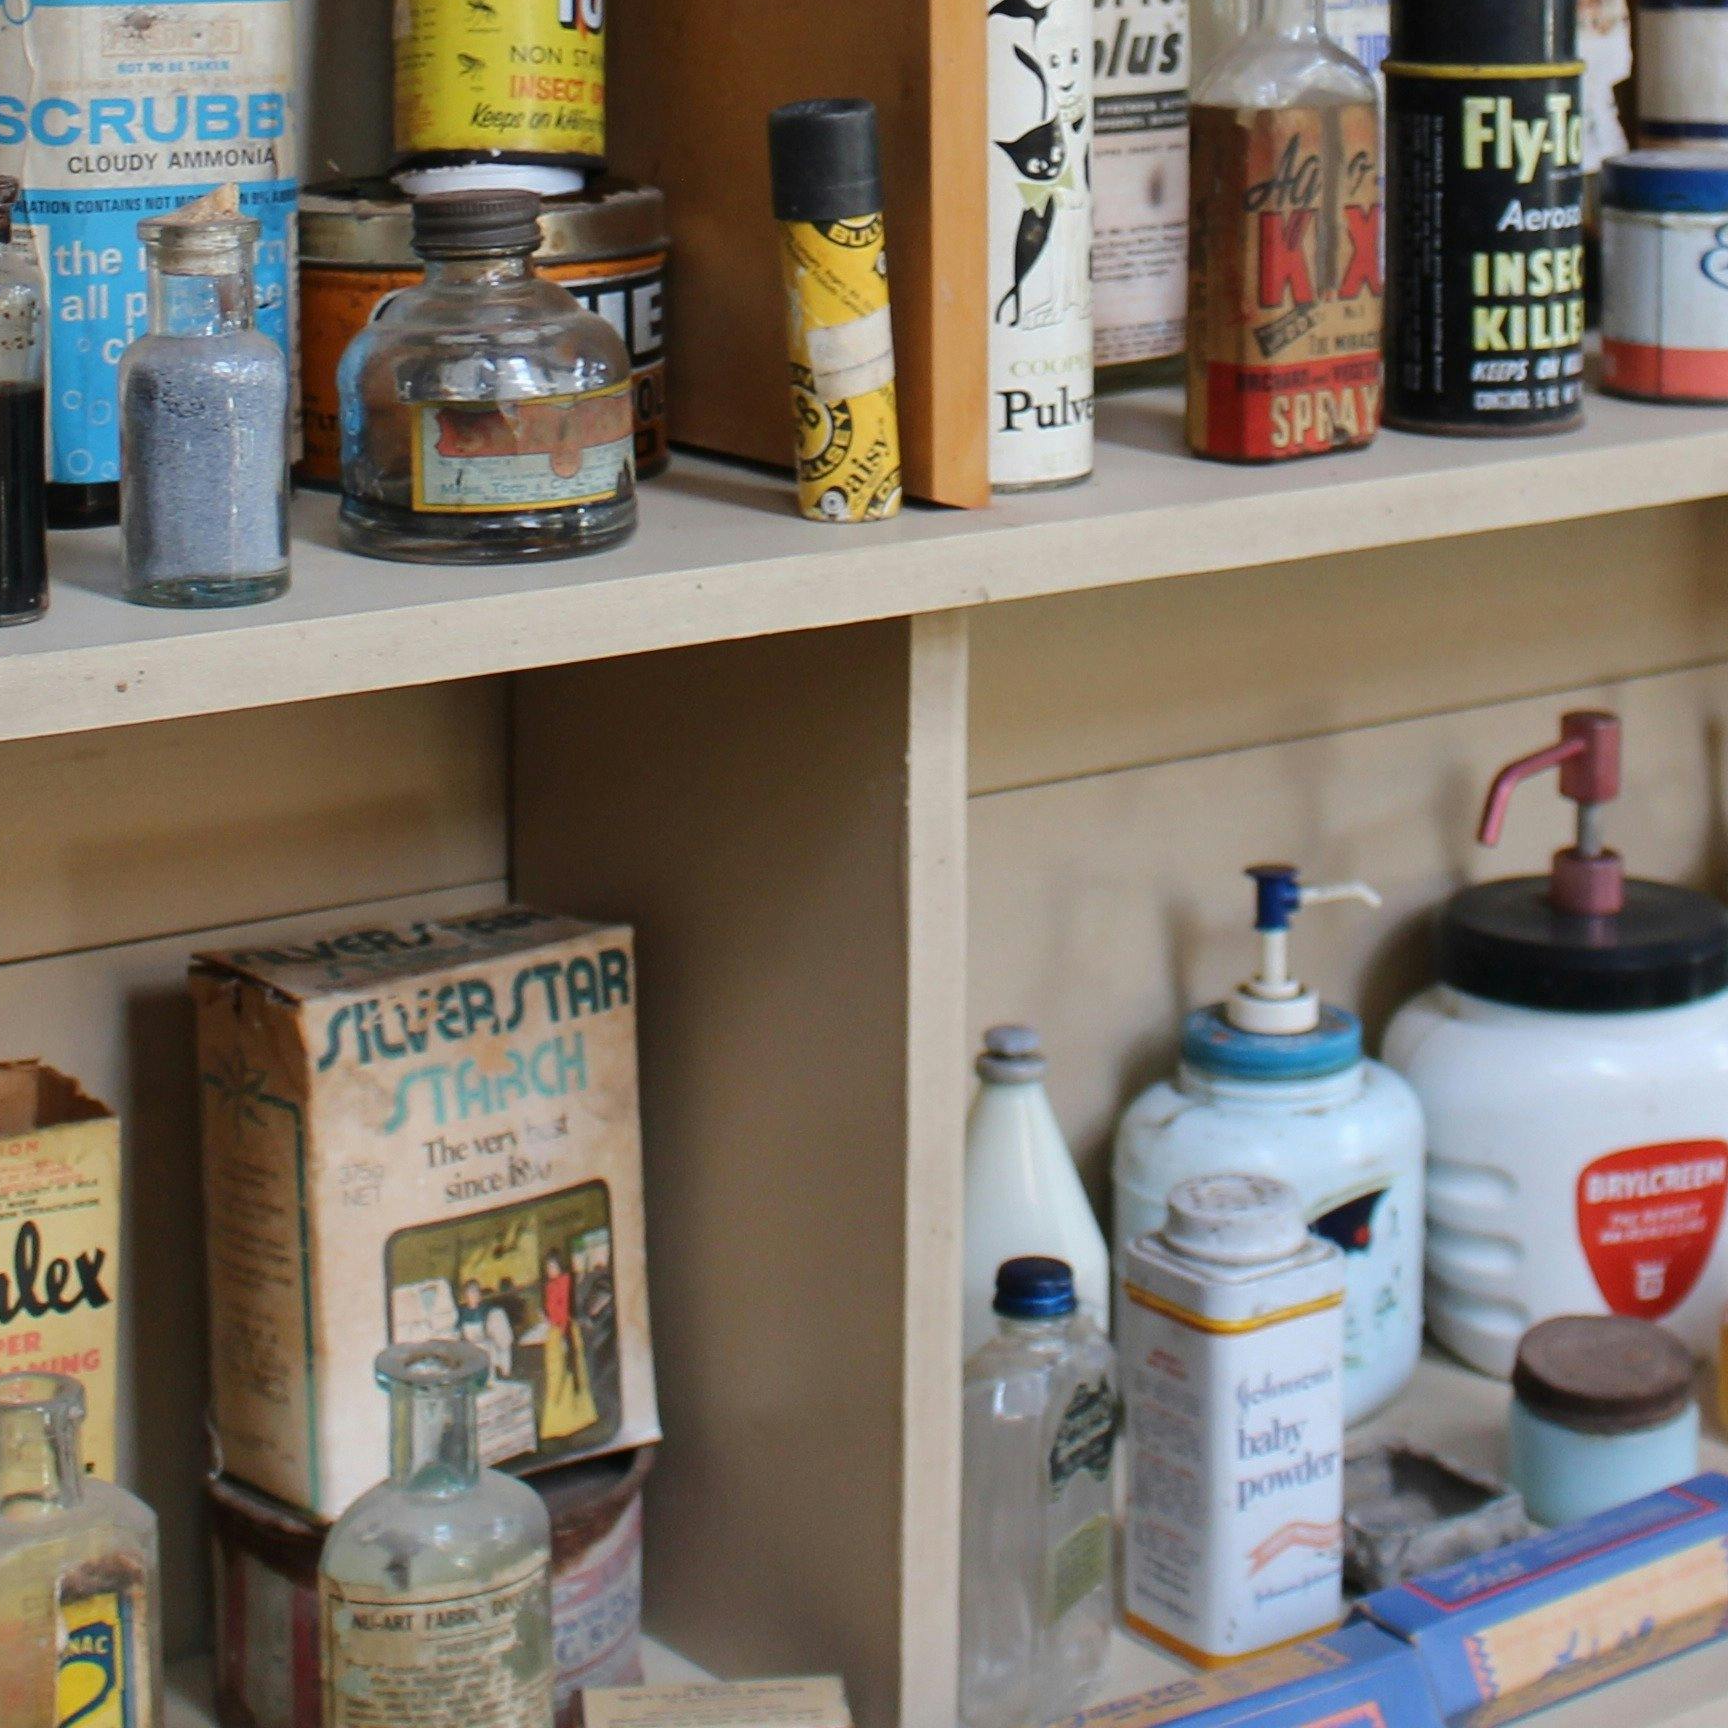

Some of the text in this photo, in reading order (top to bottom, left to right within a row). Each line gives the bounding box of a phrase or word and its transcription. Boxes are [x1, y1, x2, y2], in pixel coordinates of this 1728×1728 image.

[509, 45, 563, 66] NON
[68, 146, 276, 174] CLOUDY AMMONIA
[75, 196, 171, 215] CONTAINS NOT
[55, 240, 123, 276] the
[61, 283, 109, 322] all
[1270, 383, 1380, 449] SPRAY
[318, 948, 632, 1073] SILVER STAR
[385, 1031, 590, 1135] STARCH
[423, 1130, 518, 1168] The very
[445, 1170, 500, 1203] since
[1238, 1419, 1306, 1459] baby
[1238, 1449, 1338, 1512] powder
